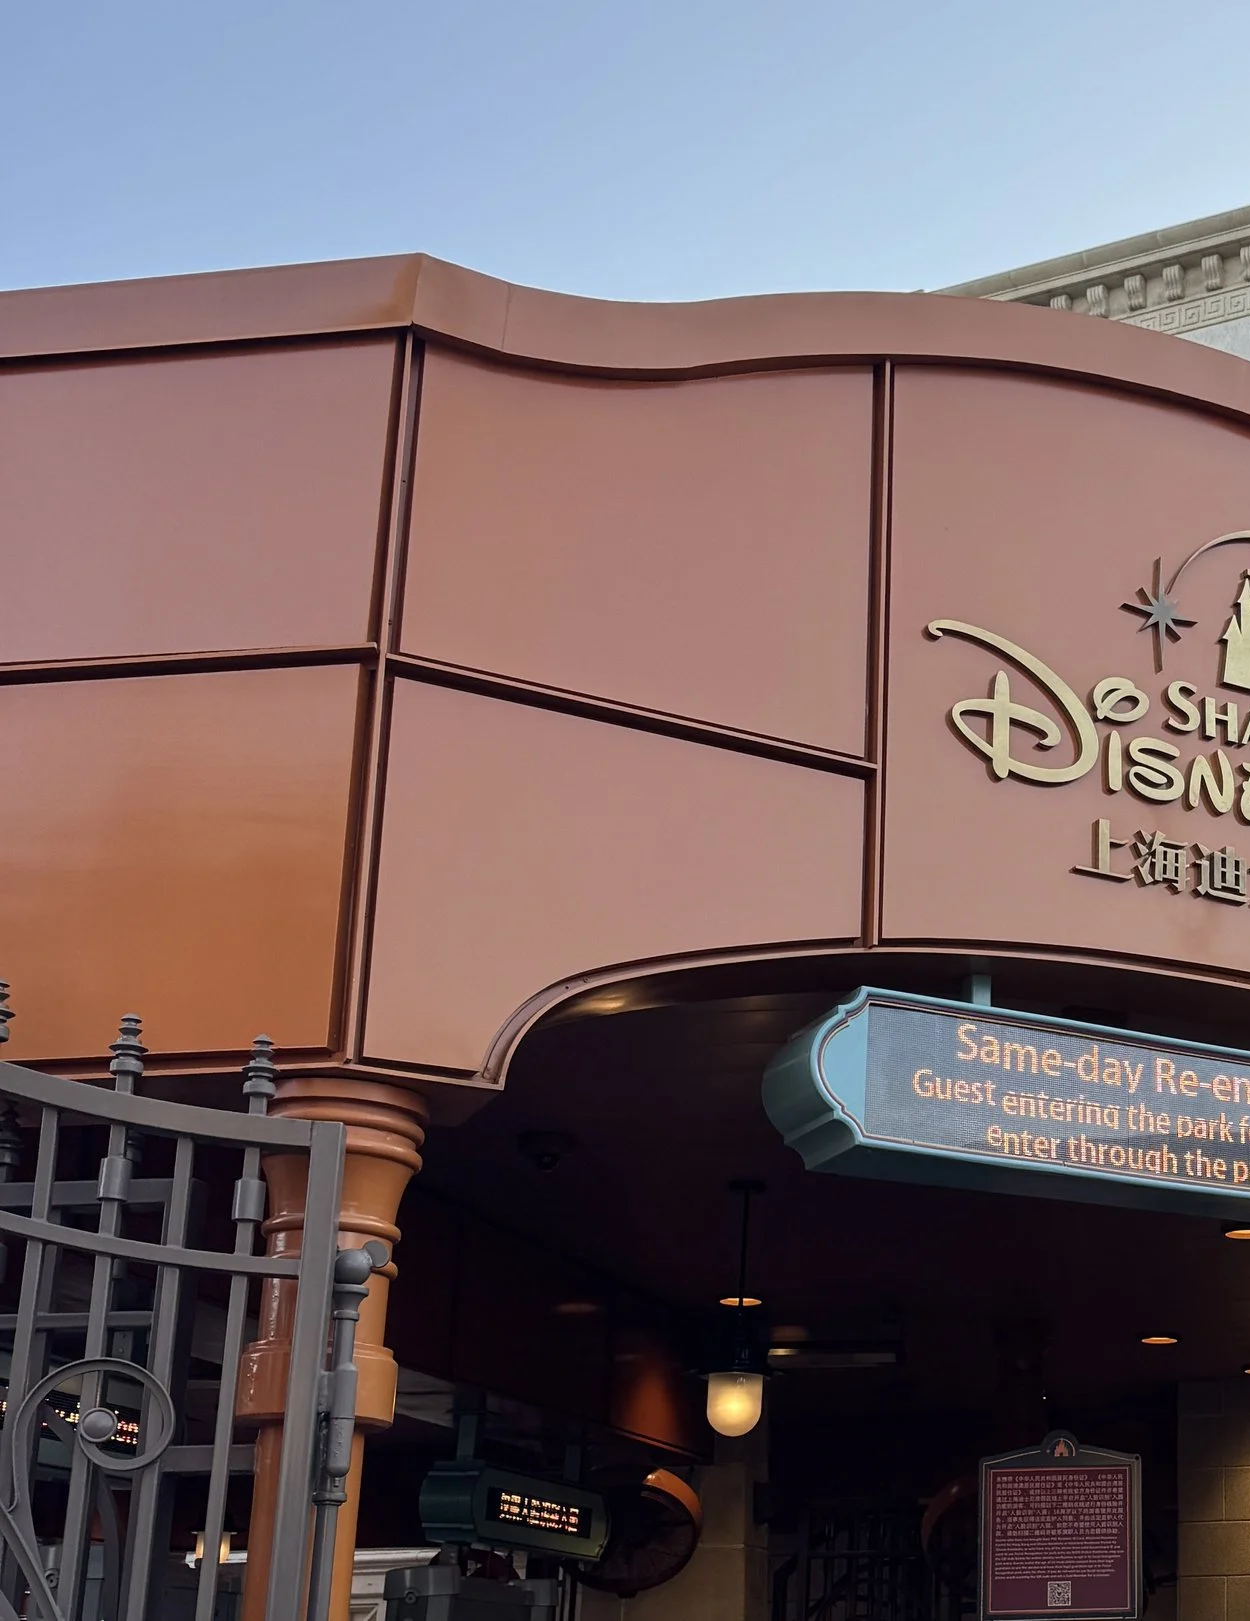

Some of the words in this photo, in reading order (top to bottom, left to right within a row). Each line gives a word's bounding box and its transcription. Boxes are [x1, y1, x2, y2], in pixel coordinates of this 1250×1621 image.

[956, 1023, 1144, 1094] Same-day
[912, 1069, 997, 1106] Guest
[1002, 1091, 1120, 1130] entering
[1126, 1102, 1171, 1135] the
[1176, 1112, 1234, 1144] park
[986, 1124, 1062, 1160] enter
[1066, 1133, 1179, 1176] through
[1183, 1148, 1228, 1180] the
